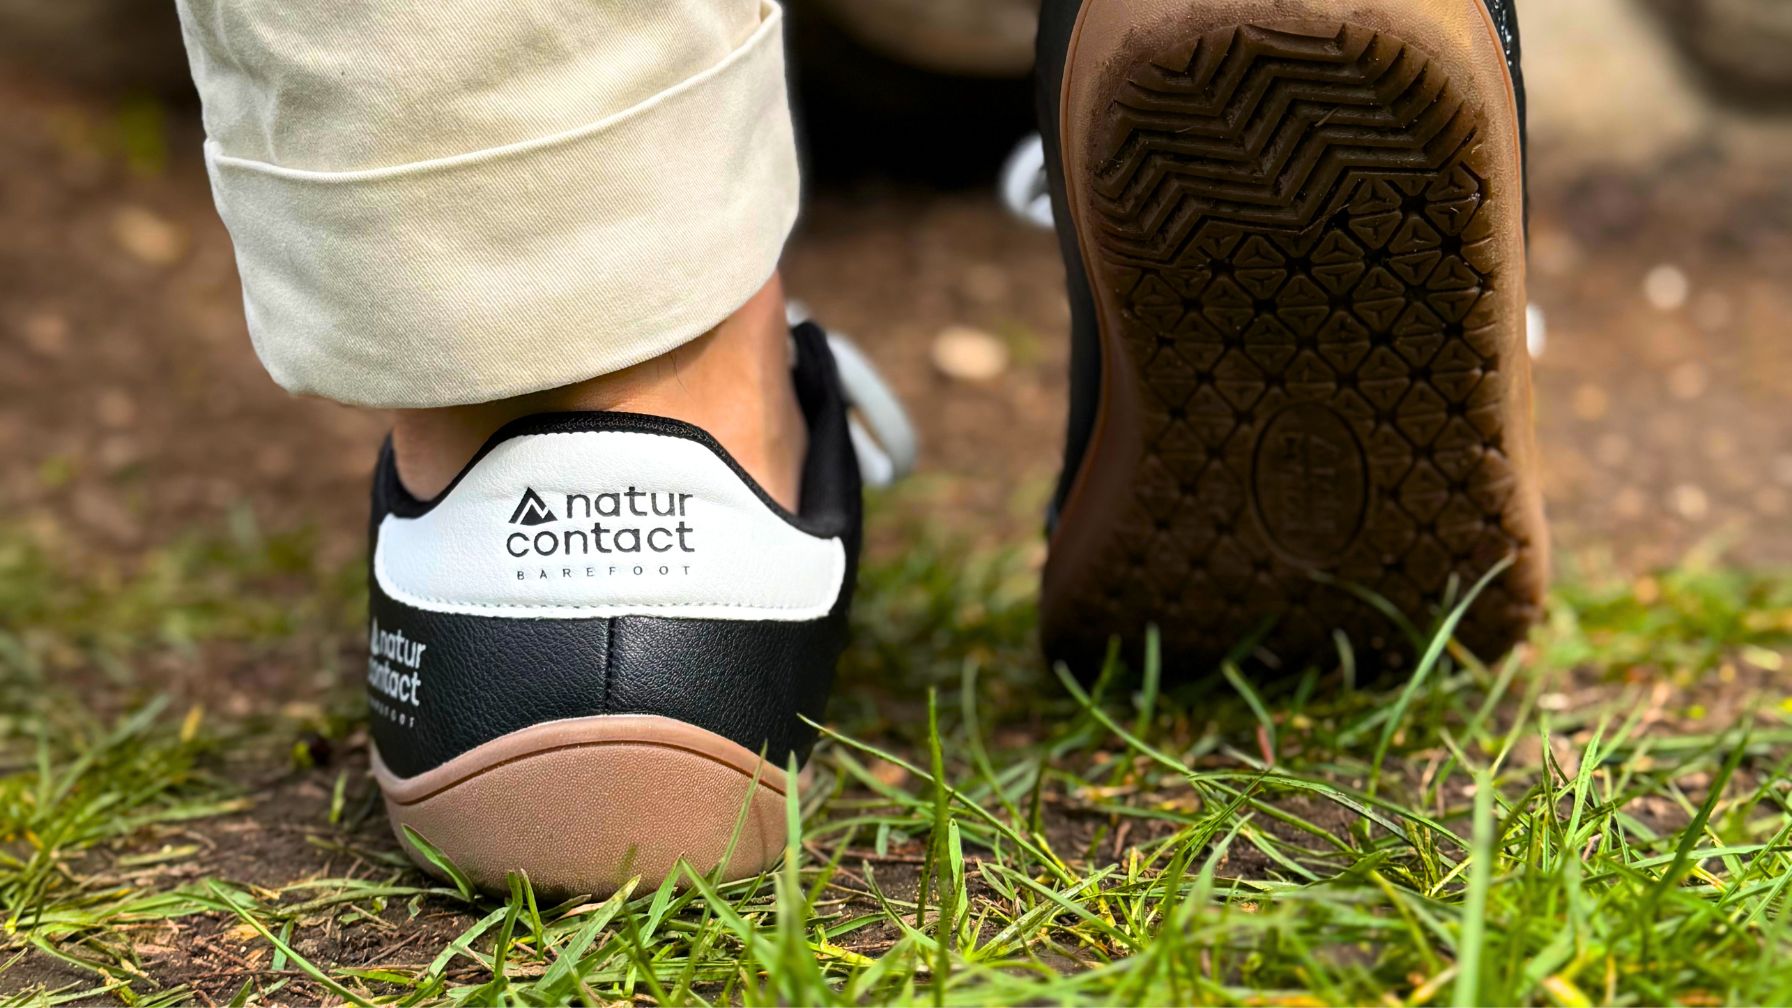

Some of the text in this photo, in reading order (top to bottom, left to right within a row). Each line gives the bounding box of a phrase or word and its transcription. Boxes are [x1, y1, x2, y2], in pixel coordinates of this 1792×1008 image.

[566, 486, 694, 519] natur
[506, 521, 696, 558] contact
[516, 565, 691, 581] BAREFOOT
[379, 629, 427, 670] natur
